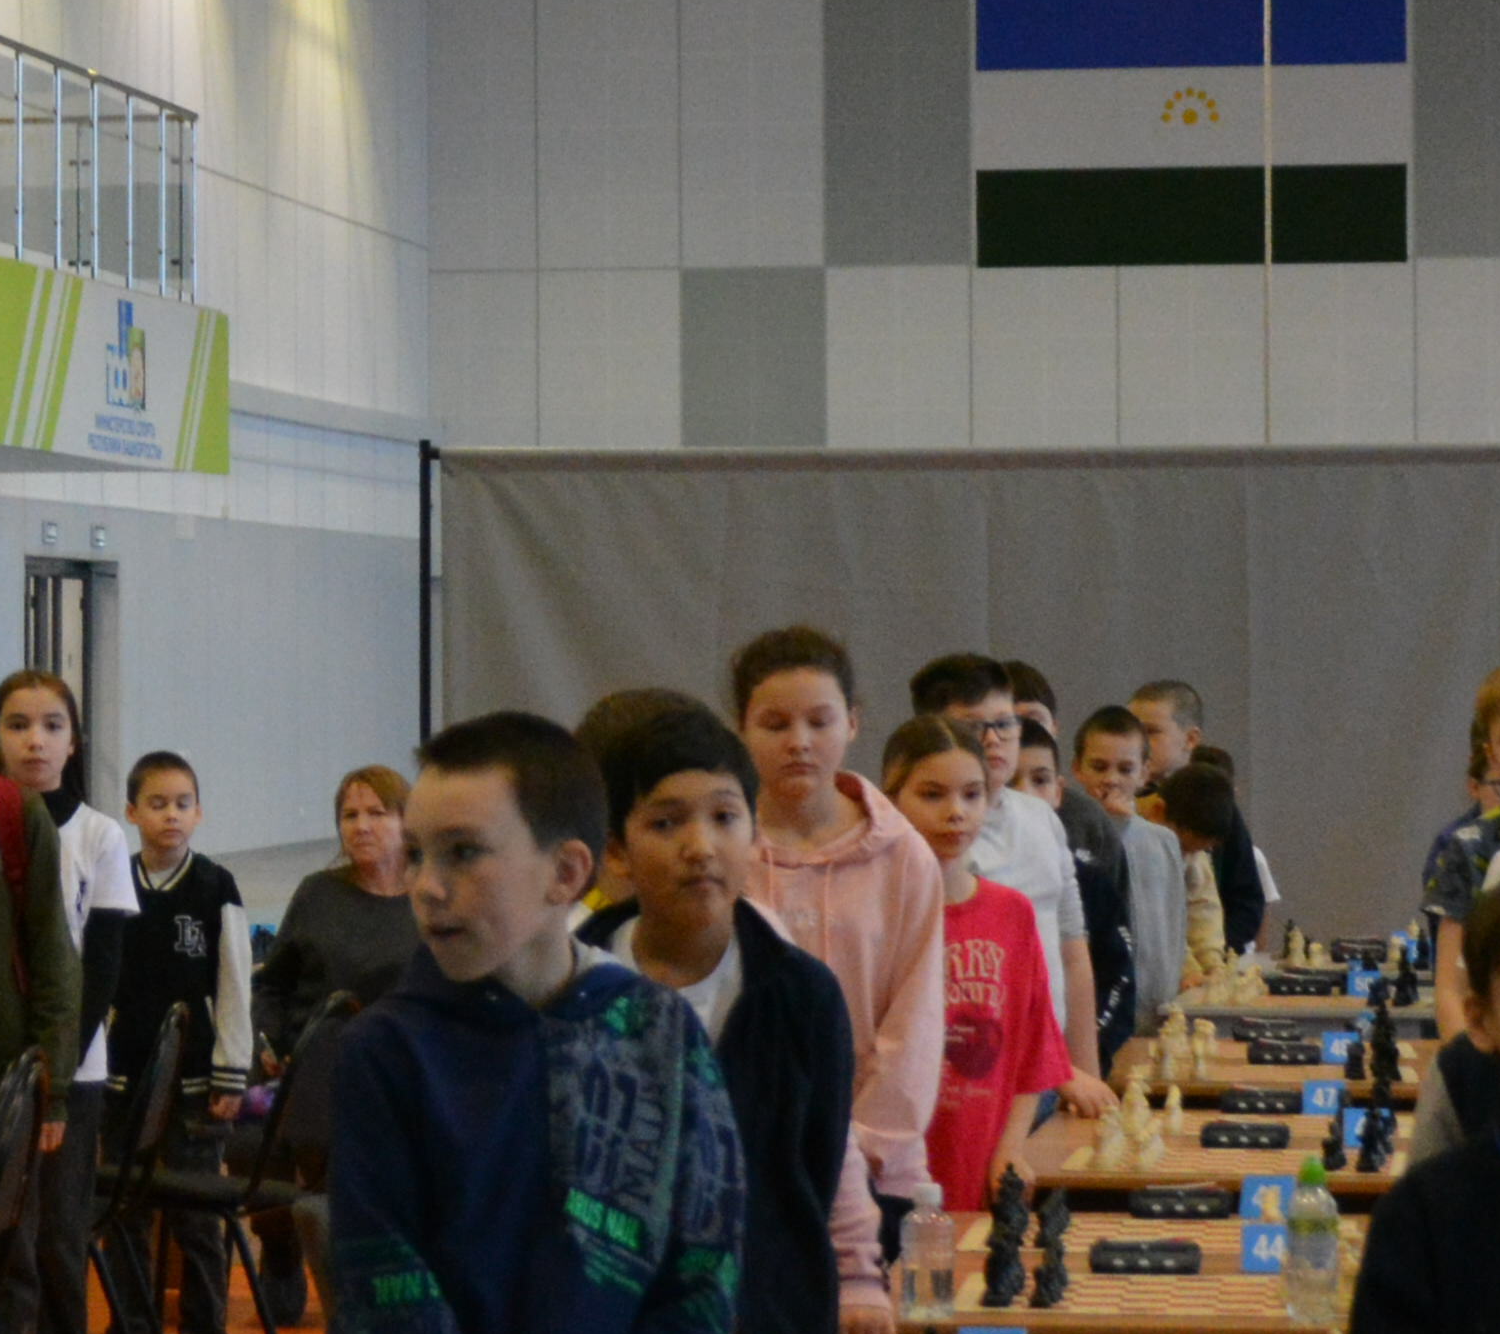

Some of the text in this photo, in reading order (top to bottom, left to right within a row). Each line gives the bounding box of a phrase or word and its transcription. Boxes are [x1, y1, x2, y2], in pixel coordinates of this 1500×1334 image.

[945, 938, 1006, 983] RRY
[1312, 1087, 1338, 1108] 47
[1252, 1234, 1286, 1262] 44
